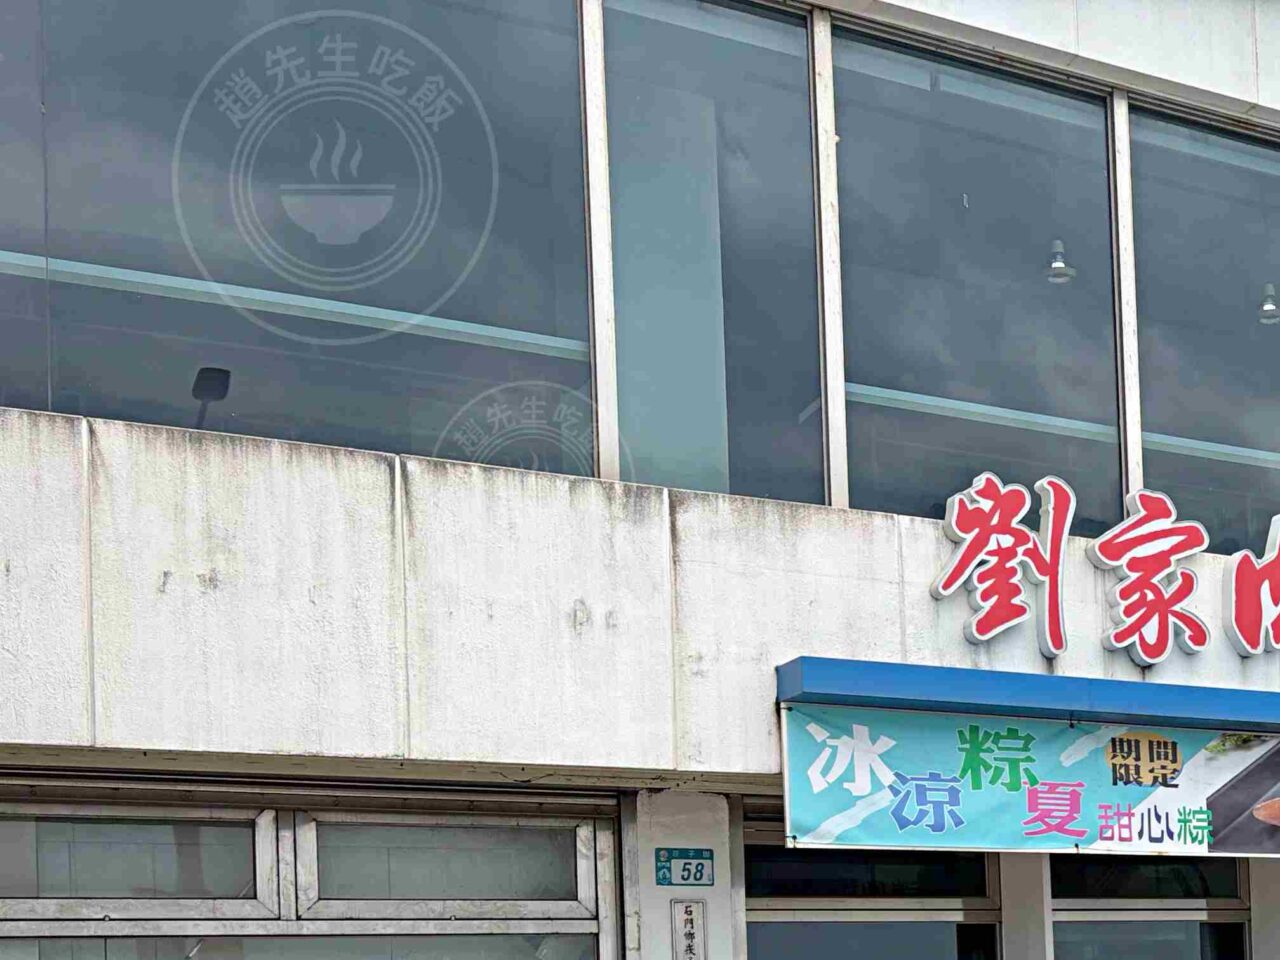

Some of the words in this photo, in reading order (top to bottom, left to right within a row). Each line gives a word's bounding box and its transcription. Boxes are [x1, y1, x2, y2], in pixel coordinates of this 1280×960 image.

[1111, 737, 1178, 763] 期間
[1112, 762, 1179, 788] 限定
[1099, 803, 1214, 845] 甜心粽
[680, 862, 704, 881] 58
